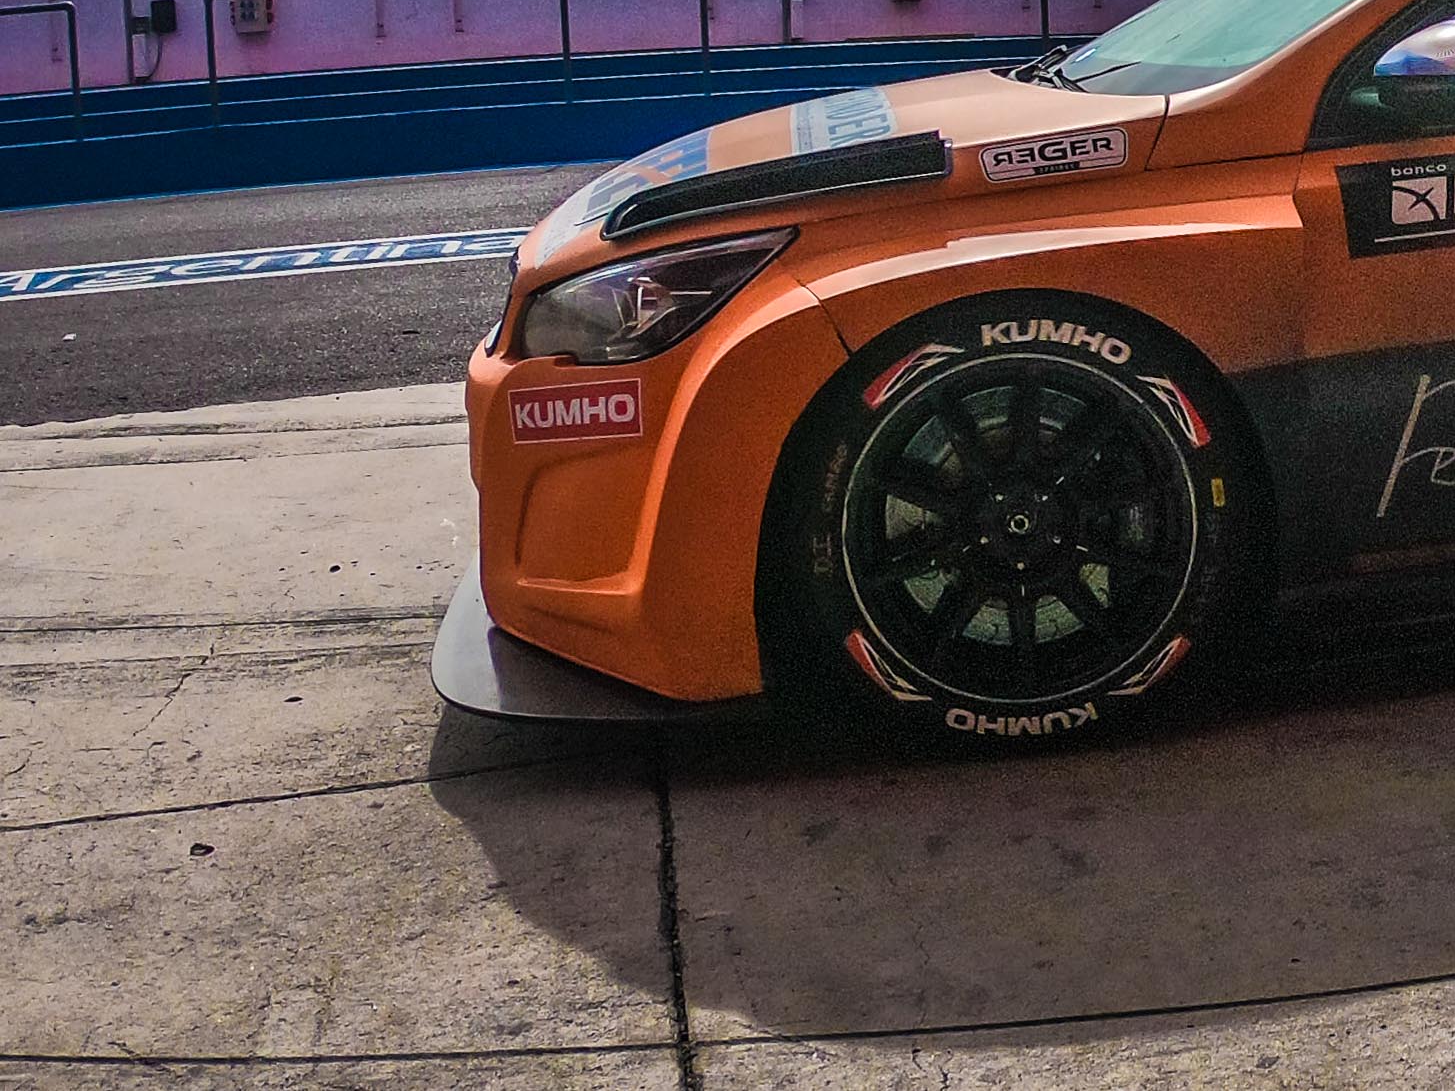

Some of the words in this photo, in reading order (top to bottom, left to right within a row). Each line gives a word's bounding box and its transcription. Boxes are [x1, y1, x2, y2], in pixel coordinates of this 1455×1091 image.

[993, 137, 1113, 167] REGER
[1391, 163, 1447, 176] banco
[0, 235, 526, 291] Argentina
[980, 319, 1133, 365] KUMHO
[514, 393, 636, 429] KUMHO
[944, 701, 1100, 736] KUMHO
